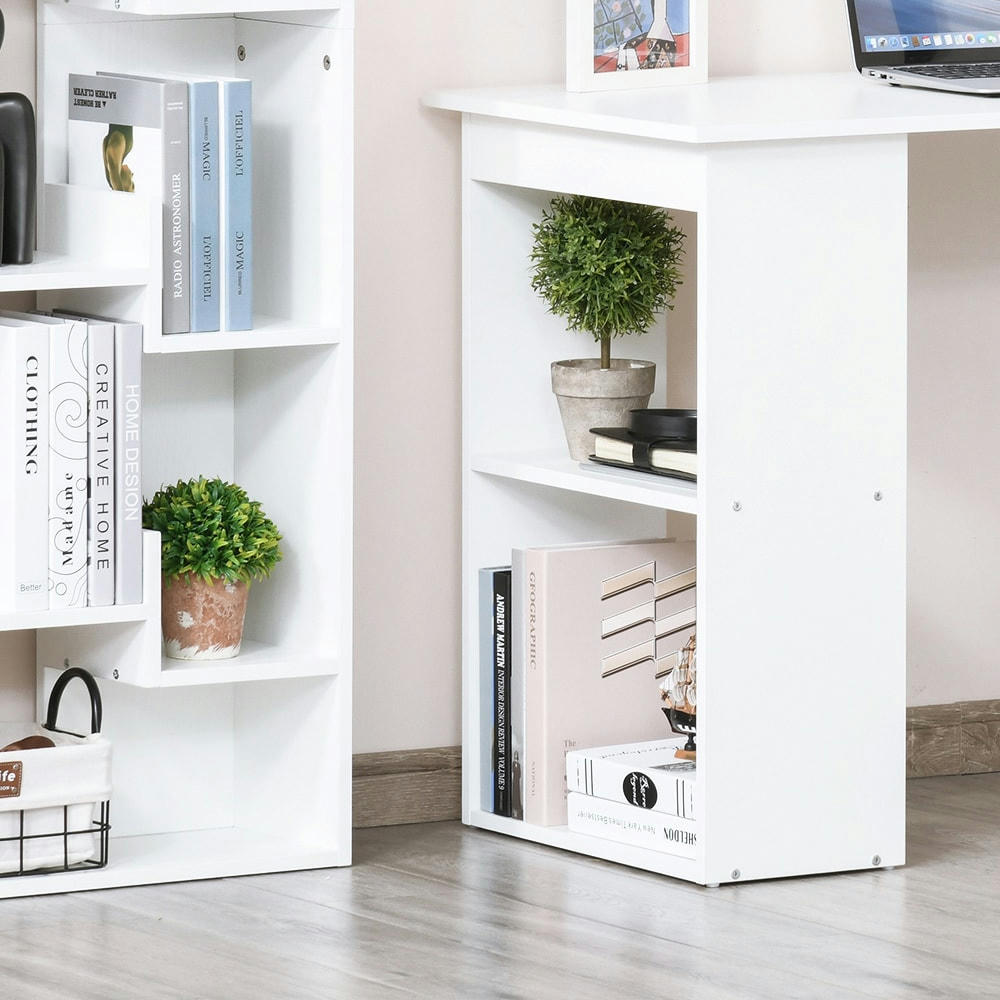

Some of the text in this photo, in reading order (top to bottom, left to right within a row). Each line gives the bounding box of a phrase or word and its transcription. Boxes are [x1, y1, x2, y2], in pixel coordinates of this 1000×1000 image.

[202, 142, 211, 182] MAGIC
[172, 172, 182, 298] RADIO ASTRONOMER
[235, 231, 244, 270] MAGIC
[25, 355, 39, 475] CLOTHING
[123, 384, 140, 521] HOME DESIGN
[95, 363, 110, 571] CREATIVE HOME
[62, 472, 74, 567] Madame
[496, 593, 505, 633] ANDREW
[496, 633, 505, 668] MARTIN
[529, 571, 537, 670] GEOGRAPHIC
